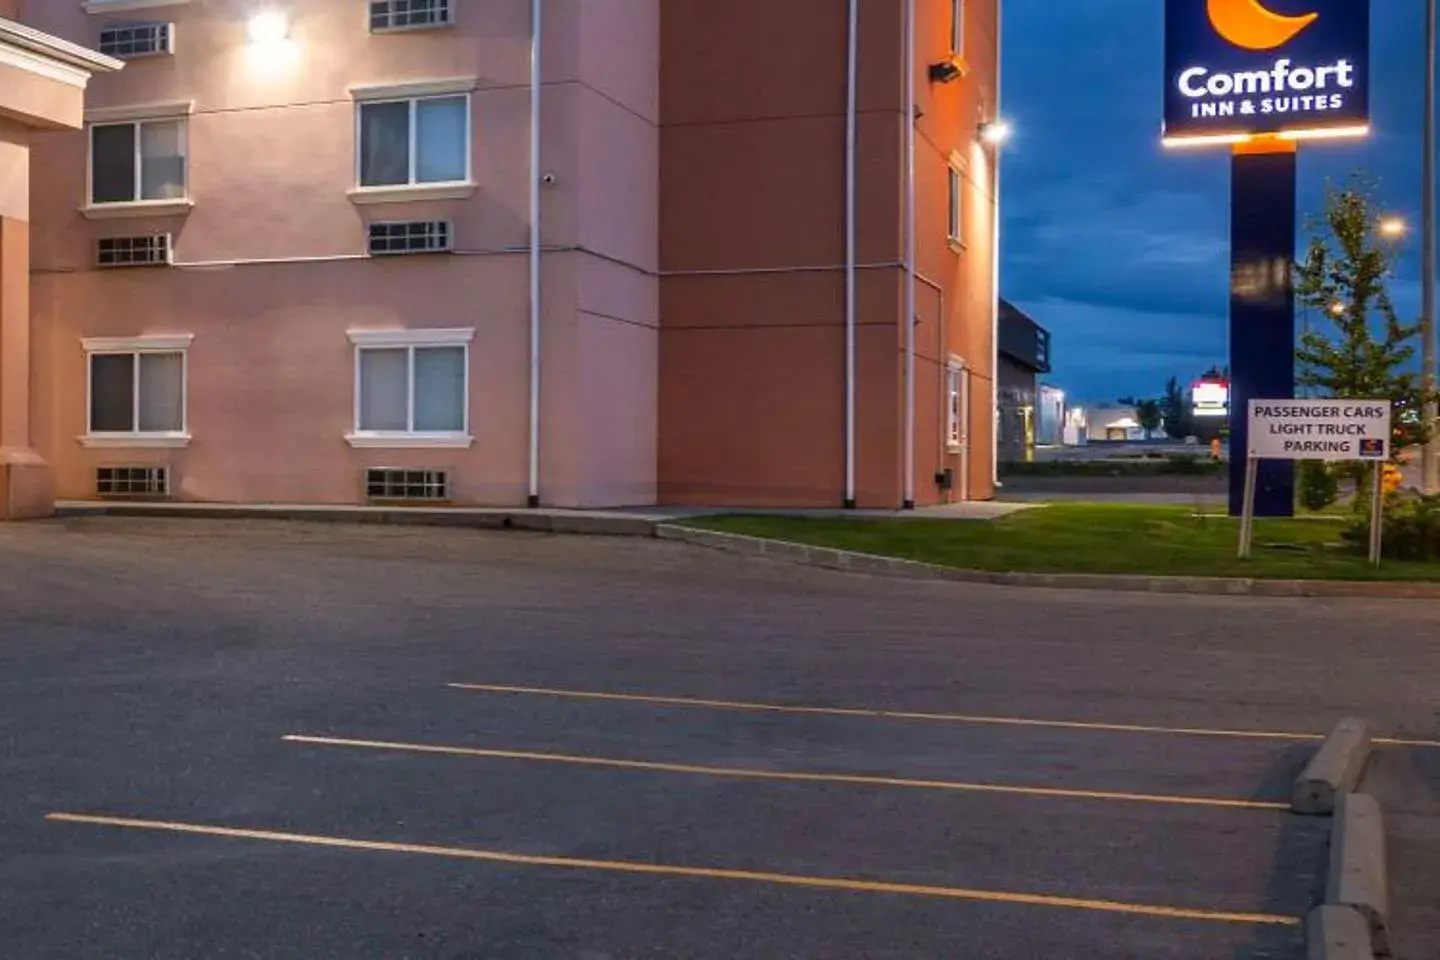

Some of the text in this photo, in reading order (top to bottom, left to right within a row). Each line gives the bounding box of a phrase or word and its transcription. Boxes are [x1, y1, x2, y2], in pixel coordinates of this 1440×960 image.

[1178, 58, 1353, 98] Comfort
[1191, 94, 1342, 117] INN & SUITES
[1254, 406, 1384, 418] PASSENGER CARS
[1270, 423, 1366, 435] LIGHT TRUCK
[1284, 440, 1351, 452] PARKING
